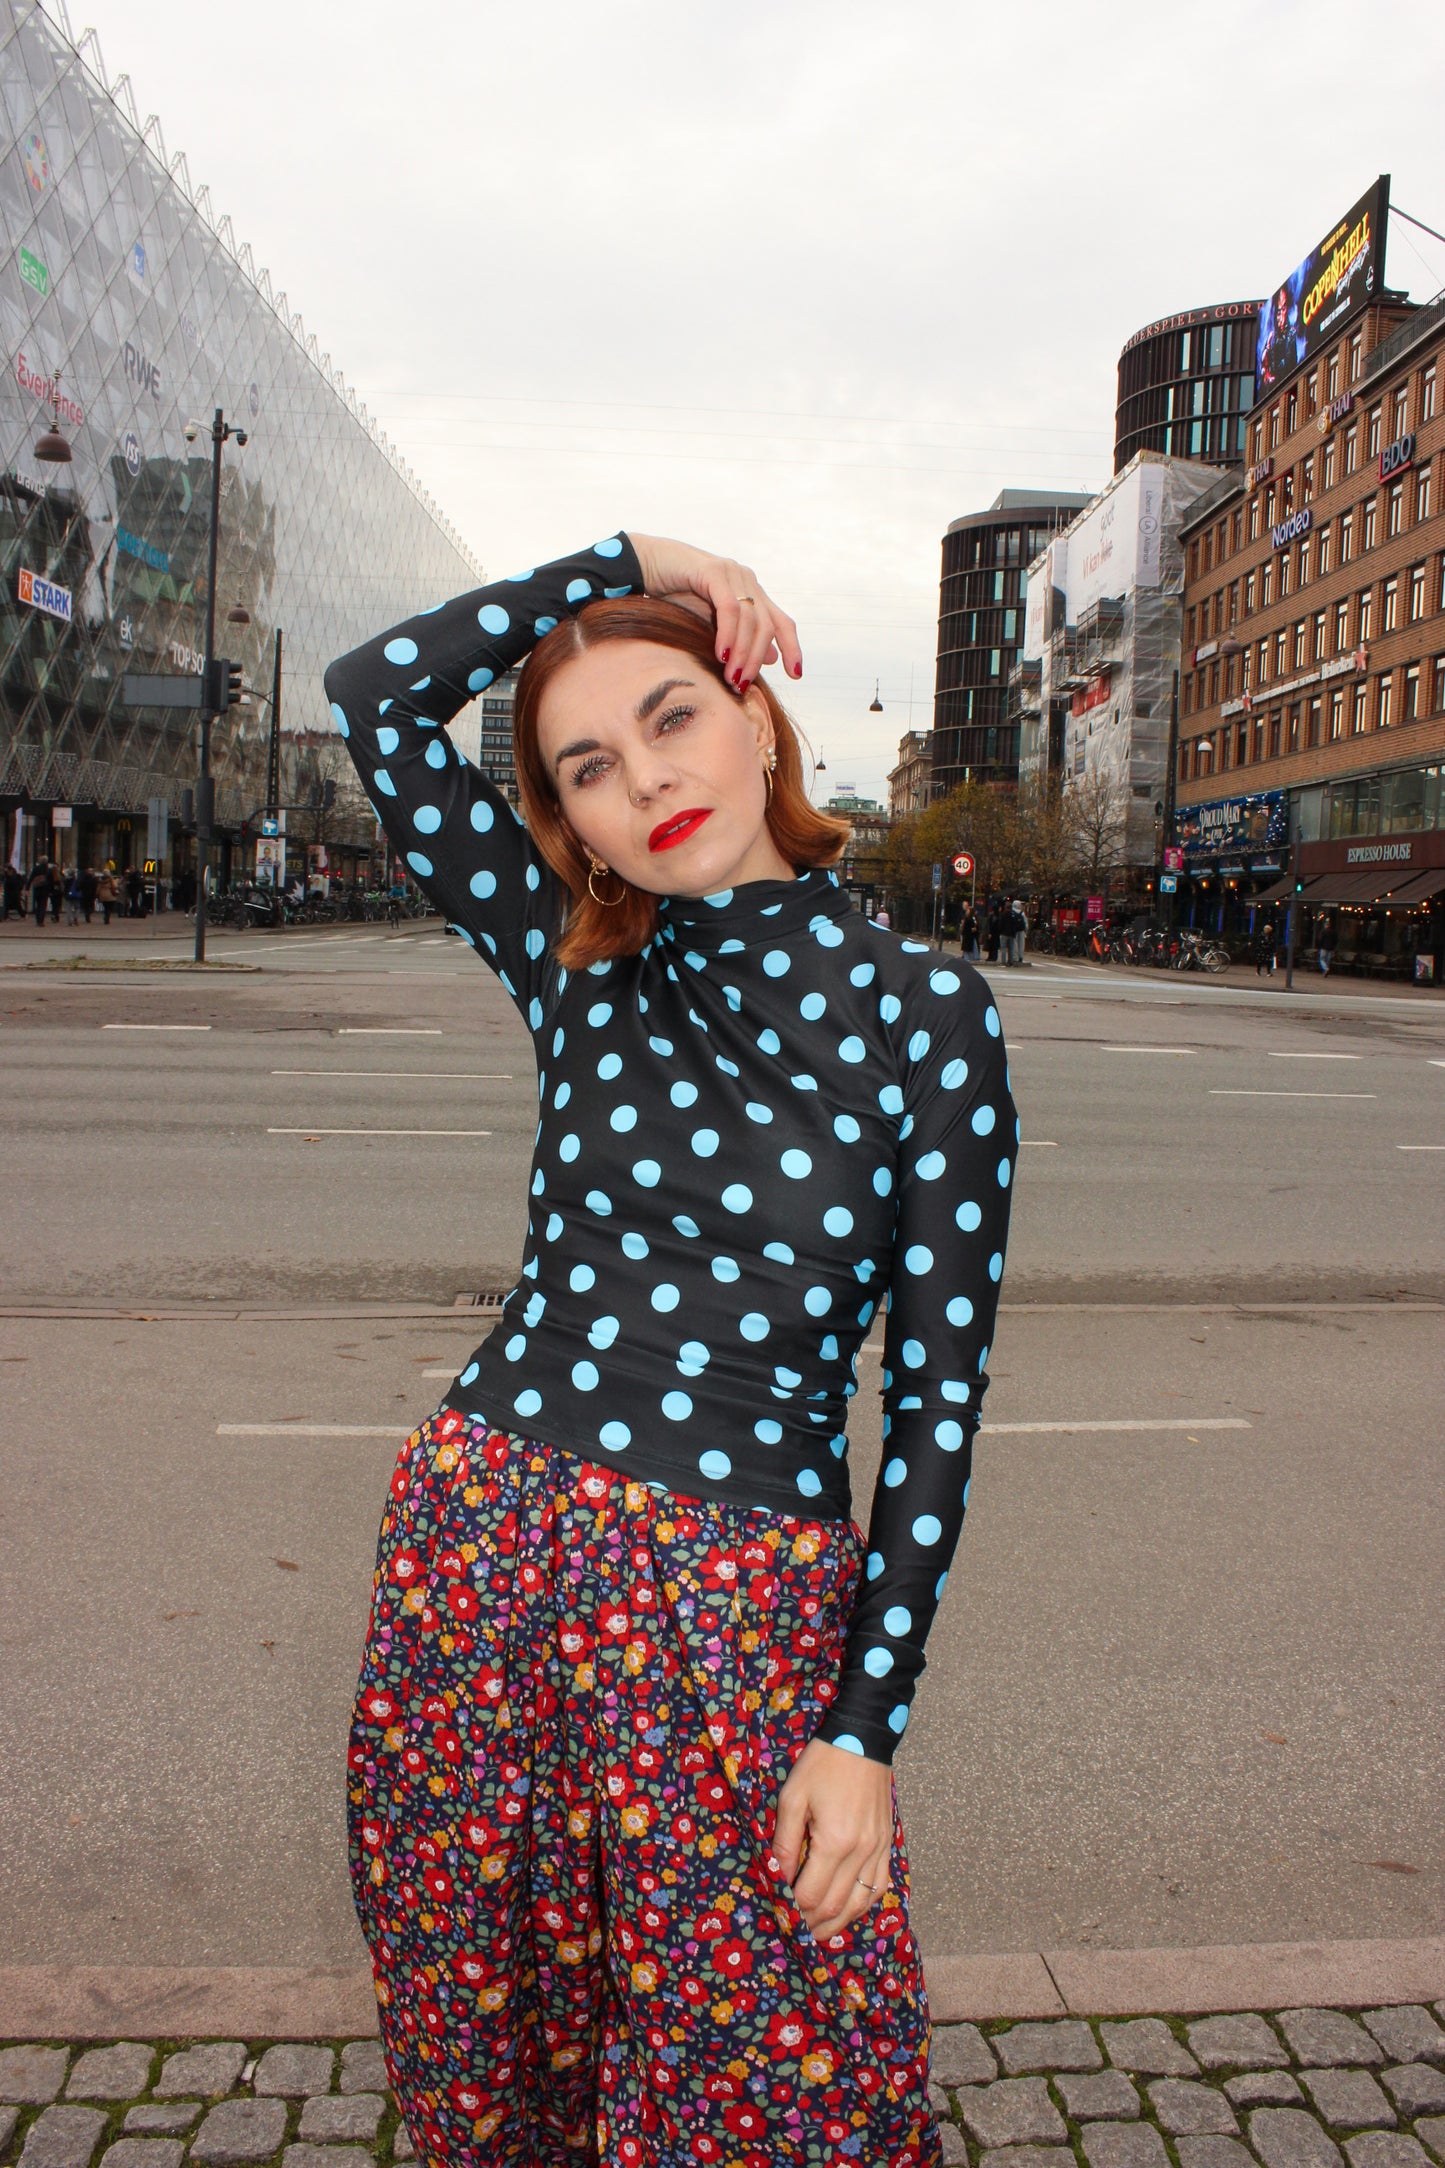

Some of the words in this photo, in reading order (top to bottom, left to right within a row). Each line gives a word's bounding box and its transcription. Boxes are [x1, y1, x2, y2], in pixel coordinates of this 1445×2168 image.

[21, 258, 46, 292] GSV
[1303, 212, 1370, 326] COPENHELL
[124, 341, 161, 401] RWE
[1329, 391, 1353, 423] THAI
[1382, 433, 1412, 476] BDO
[33, 579, 70, 617] STARK
[956, 861, 969, 870] 40
[1347, 845, 1383, 863] ESPRESSO
[1383, 843, 1412, 861] HOUSE
